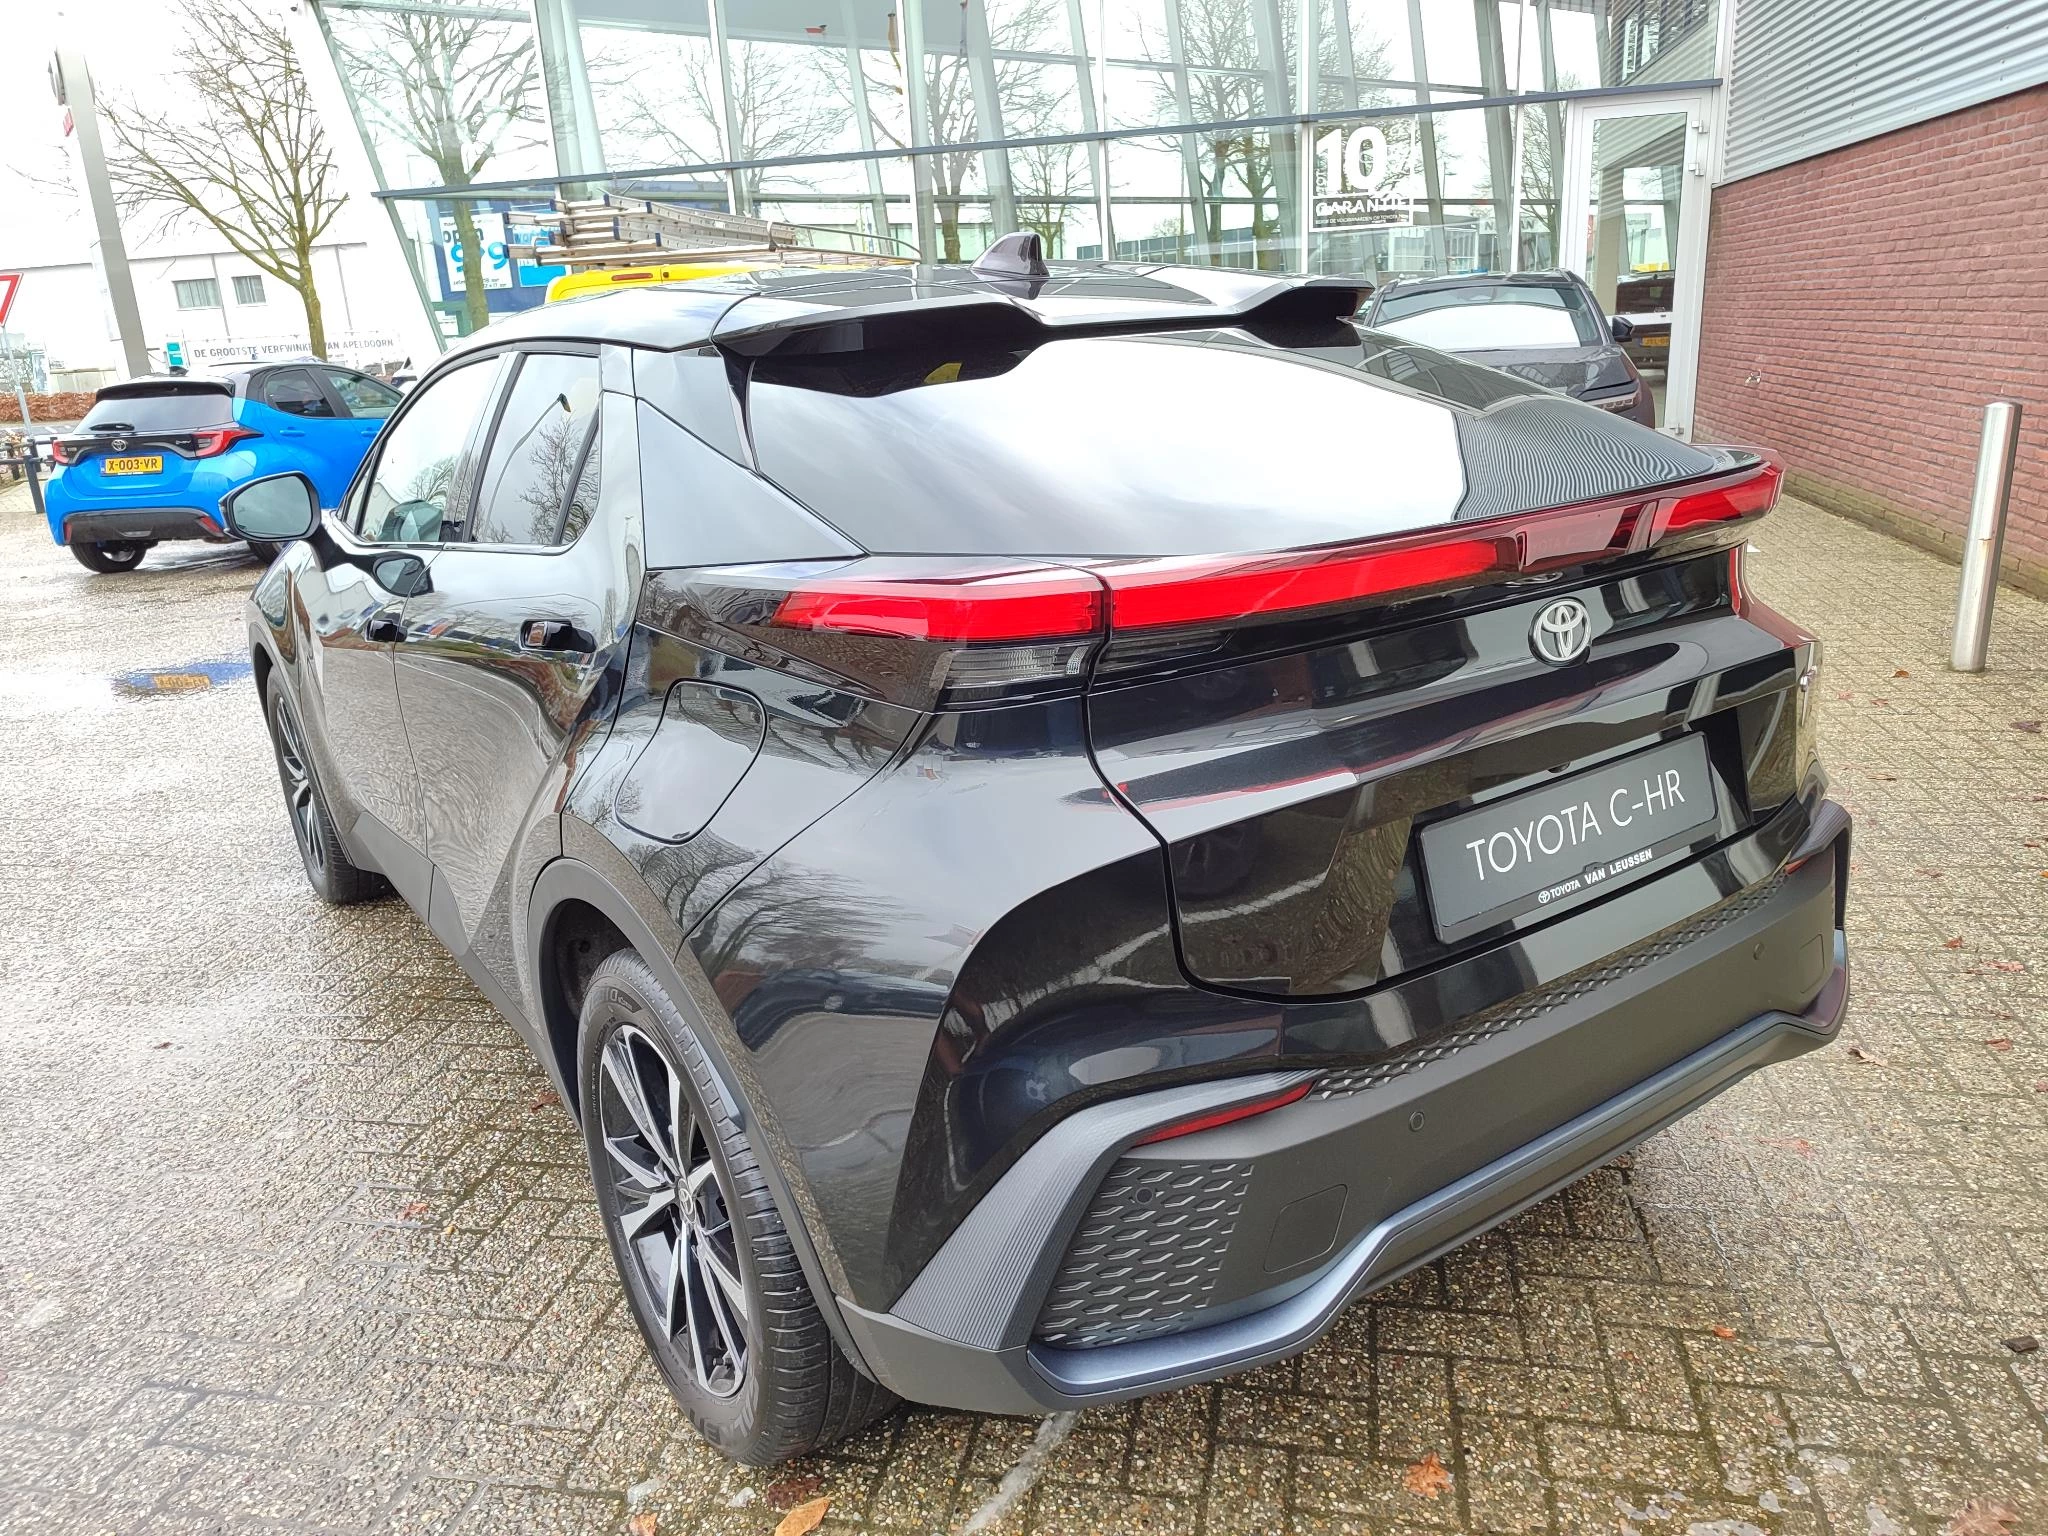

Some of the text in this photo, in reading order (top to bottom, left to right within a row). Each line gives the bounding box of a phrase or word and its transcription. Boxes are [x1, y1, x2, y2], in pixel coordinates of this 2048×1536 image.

[1316, 126, 1387, 193] 10
[1315, 198, 1409, 217] GARANTIE
[443, 228, 484, 246] opn
[194, 339, 394, 358] DE GROOTSTE VERFWINKE AN APELDOORN
[108, 458, 157, 471] X-003-VR
[1466, 769, 1685, 881] TOYOTA C-HR
[1550, 848, 1653, 899] TOYOTA VAN LEUSSEN
